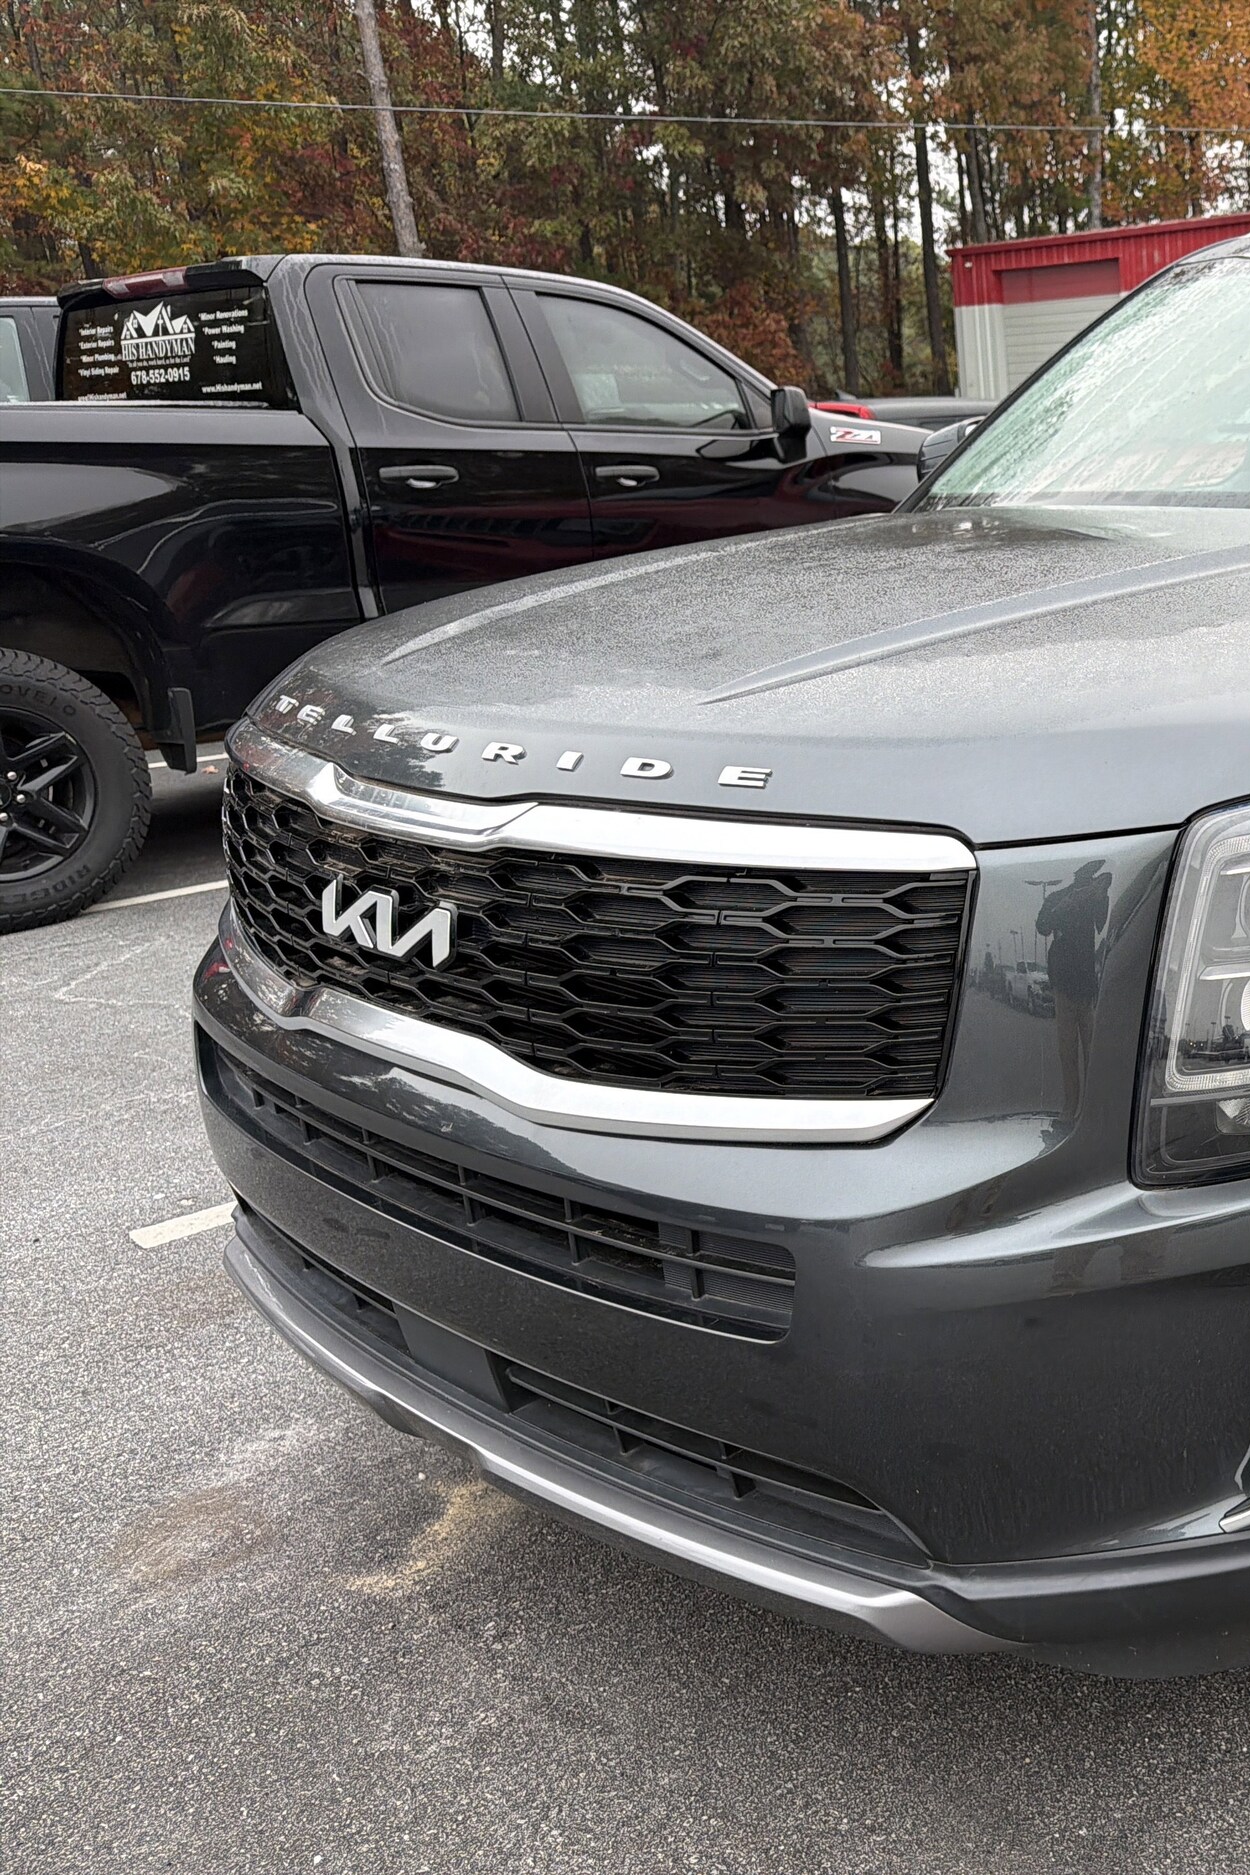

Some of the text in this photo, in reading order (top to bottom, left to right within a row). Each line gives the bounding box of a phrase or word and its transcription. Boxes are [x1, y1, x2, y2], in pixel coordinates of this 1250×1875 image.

[216, 308, 248, 319] Renovations
[97, 325, 114, 334] Repairs
[221, 323, 245, 334] Washing
[98, 339, 115, 348] Repairs
[121, 337, 195, 361] HIS HANDYMAN
[104, 365, 119, 374] Repair
[131, 366, 190, 385] 678-552-0915
[276, 694, 774, 790] TELLURIDE
[321, 875, 457, 971] KIA
